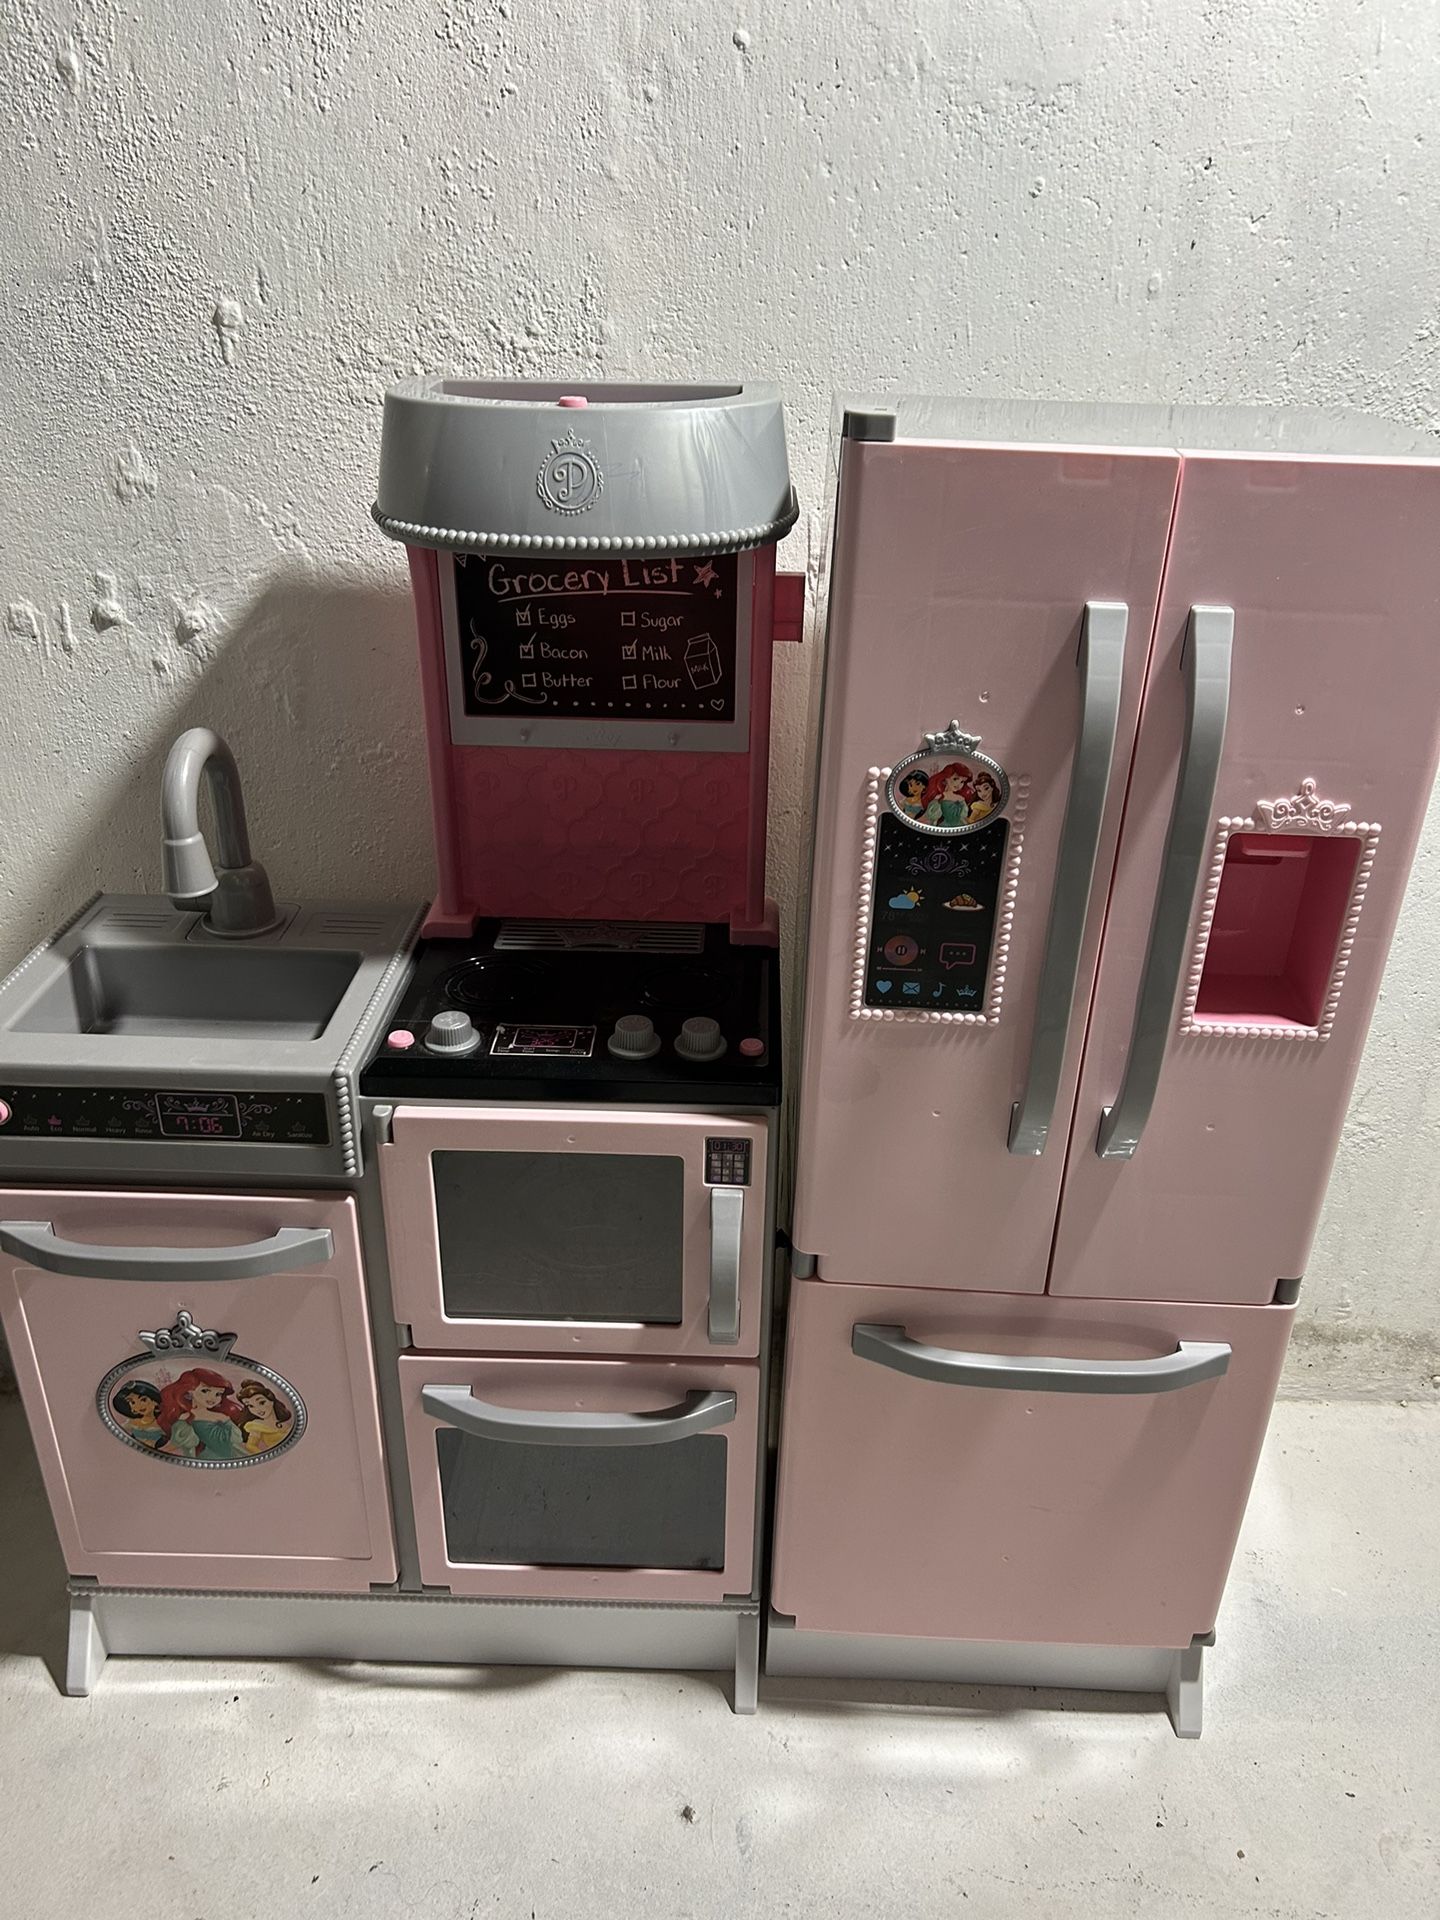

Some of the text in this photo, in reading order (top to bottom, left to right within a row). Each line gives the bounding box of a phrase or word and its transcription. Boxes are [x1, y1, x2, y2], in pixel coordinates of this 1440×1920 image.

[488, 558, 684, 596] Grocery List
[538, 607, 576, 629] Eggs
[640, 611, 685, 632] Sugar
[540, 644, 589, 660] Bacon
[642, 646, 673, 662] Milk
[542, 672, 594, 689] Butter
[642, 673, 683, 690] Flour
[175, 1116, 224, 1134] 7:06
